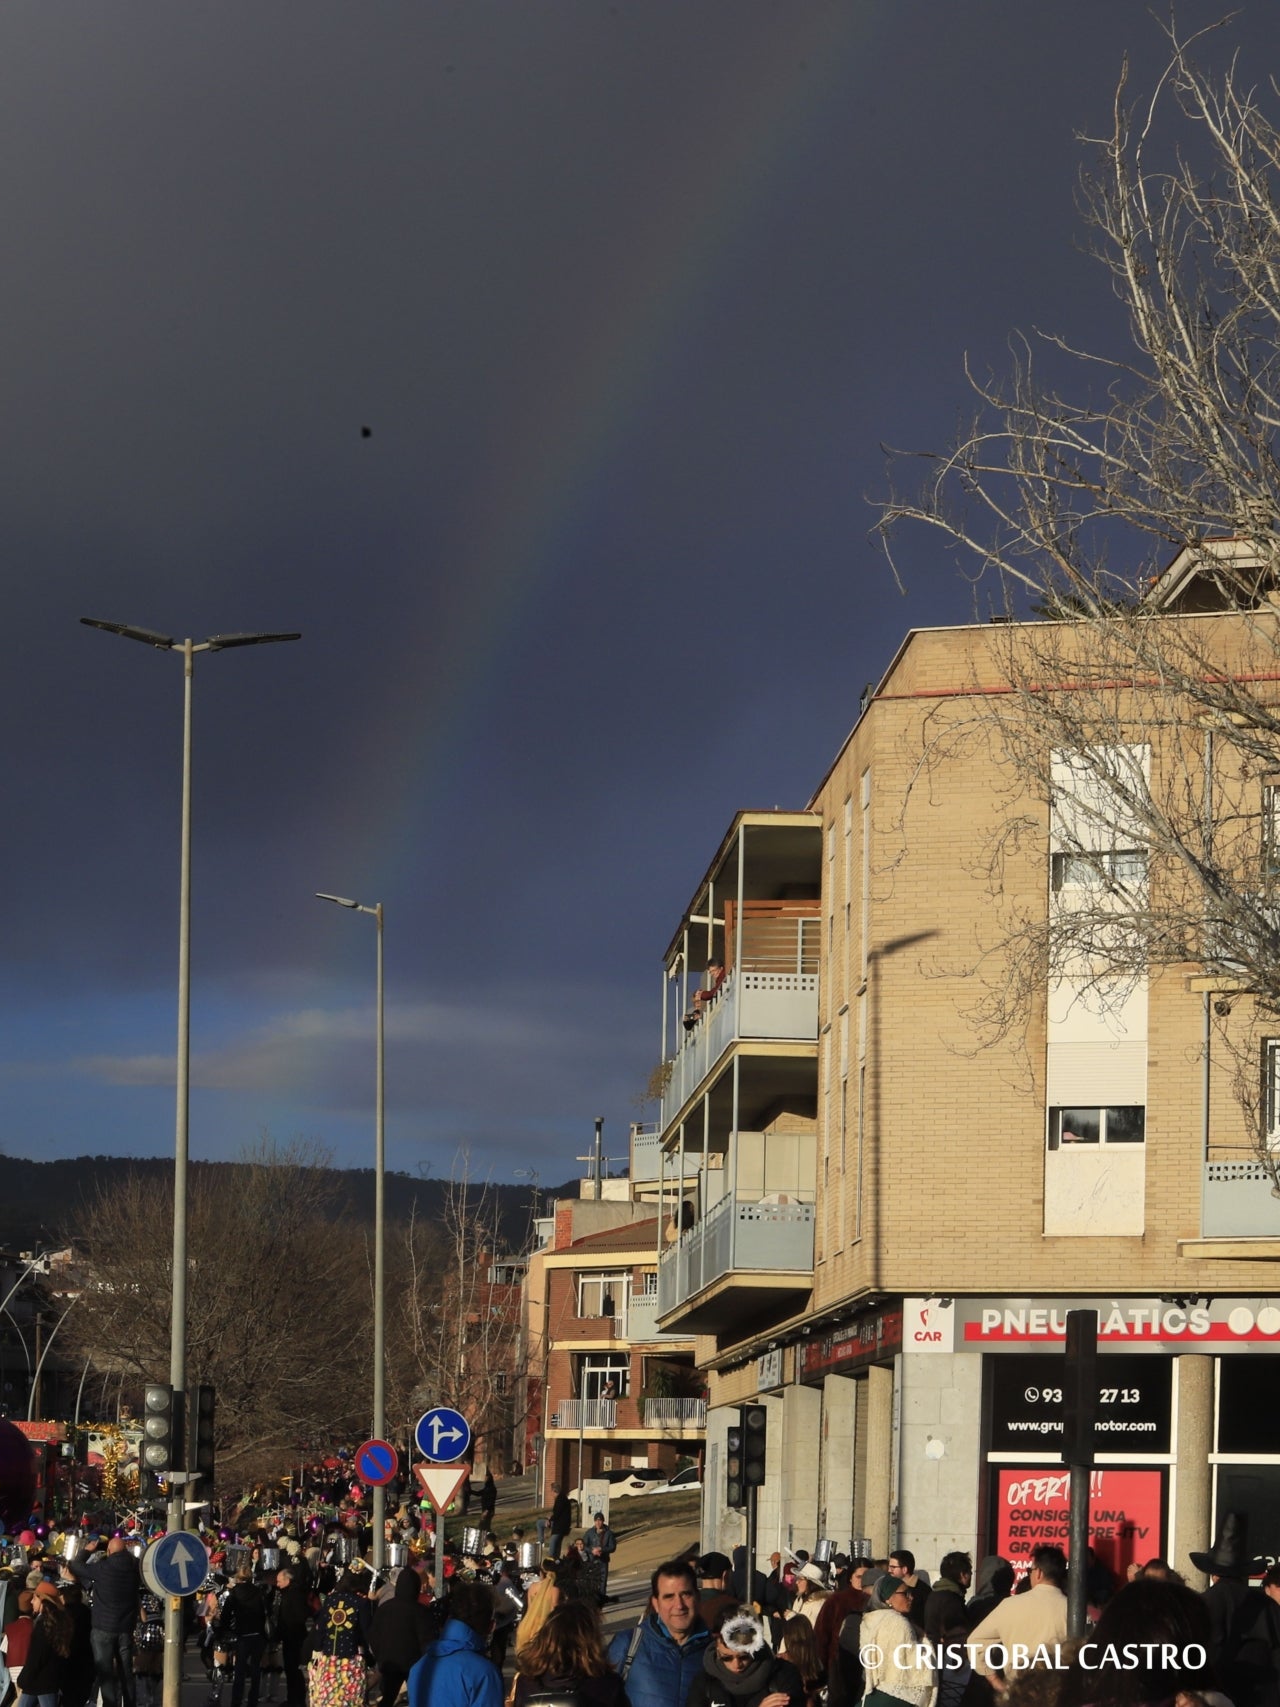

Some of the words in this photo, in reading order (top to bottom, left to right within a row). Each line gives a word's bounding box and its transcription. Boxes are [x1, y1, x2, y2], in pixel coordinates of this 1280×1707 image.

[981, 1302, 1211, 1335] PNEUÀTICS
[914, 1331, 942, 1342] CAR
[1042, 1388, 1063, 1403] 93
[1099, 1388, 1118, 1403] 27
[1121, 1388, 1140, 1403] 13
[1008, 1420, 1157, 1434] www.grumotor.com
[1007, 1471, 1104, 1506] OFERT!!
[1009, 1509, 1070, 1522] CONSIG
[1094, 1510, 1127, 1522] UNA
[1008, 1522, 1070, 1538] REVISIÓ
